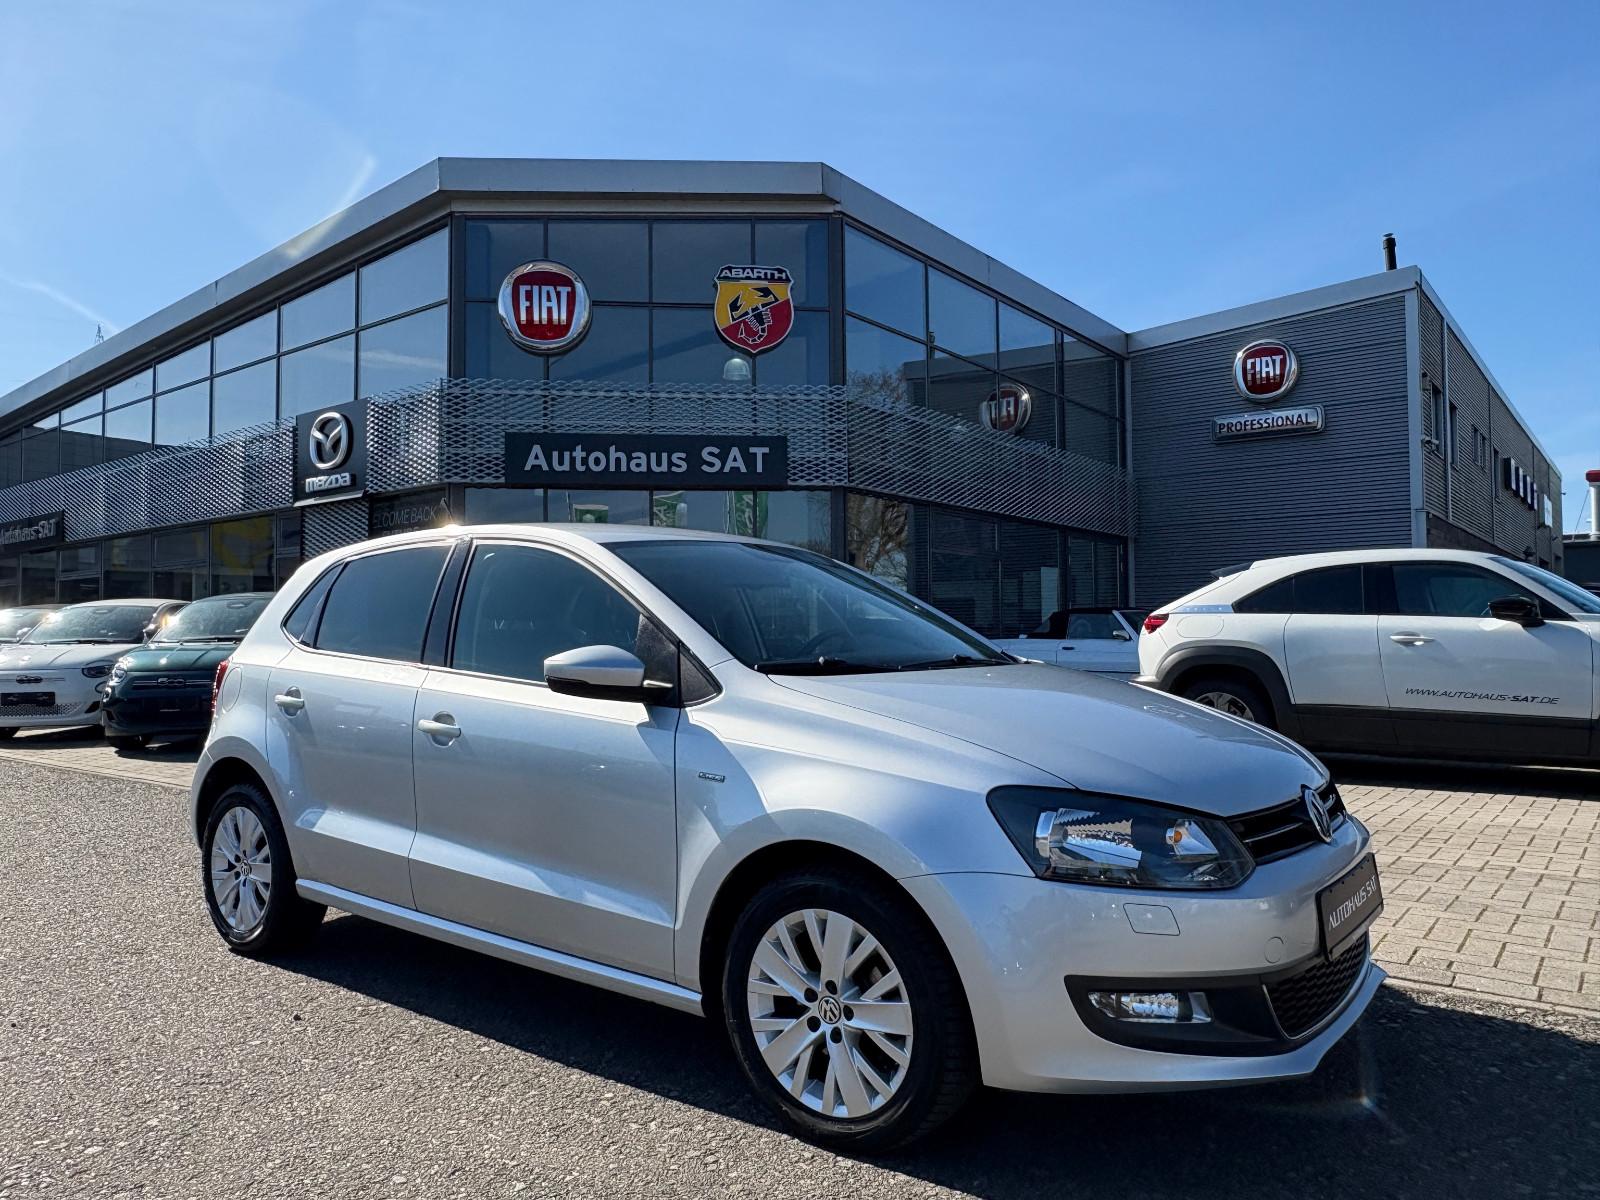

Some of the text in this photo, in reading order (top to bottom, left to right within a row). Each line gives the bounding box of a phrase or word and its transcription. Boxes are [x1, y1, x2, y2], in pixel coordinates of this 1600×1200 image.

[720, 268, 786, 280] ABARTH
[519, 284, 572, 325] FIAT
[1246, 354, 1284, 386] FIAT
[1217, 413, 1312, 434] PROFESSIONAL
[523, 444, 770, 473] Autohaus SAT
[1329, 875, 1377, 931] AUTOHAUS SAT
